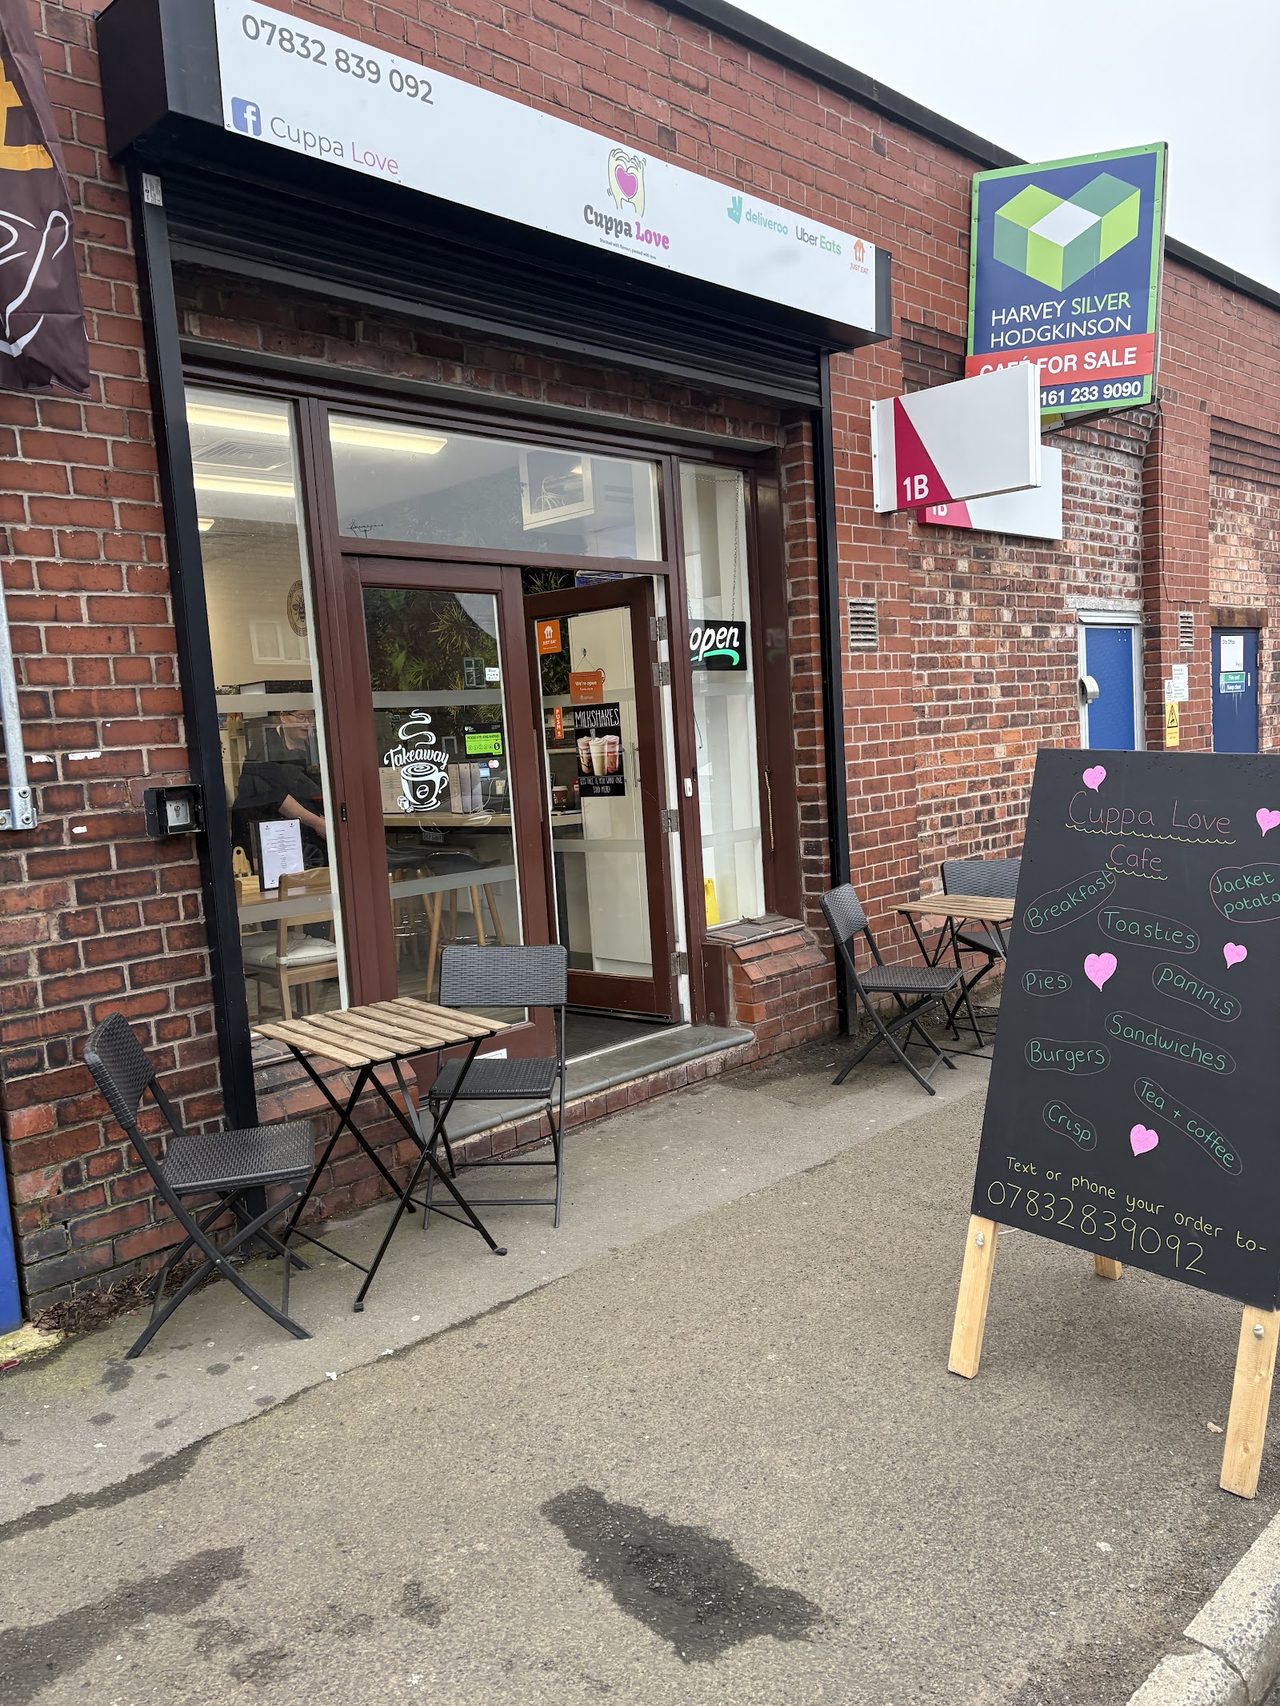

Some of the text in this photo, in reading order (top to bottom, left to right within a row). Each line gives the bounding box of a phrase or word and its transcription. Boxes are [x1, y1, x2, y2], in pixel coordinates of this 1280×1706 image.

[241, 14, 434, 105] 07832 839 092
[270, 116, 399, 175] Cuppa Love
[583, 204, 670, 250] Cuppa Love
[745, 208, 789, 235] deliveroo
[795, 225, 842, 256] Uber Eats
[849, 262, 869, 275] JUST EAT
[991, 292, 1132, 327] HARVEY SILVER
[990, 315, 1132, 349] HODGKINSON
[1037, 354, 1078, 374] FOR
[1083, 346, 1137, 370] SALE
[1041, 381, 1142, 406] 161 233 9090
[903, 473, 929, 502] 1B
[690, 626, 740, 662] open
[574, 708, 620, 728] MILKSHAKES
[383, 744, 450, 771] Takeaway
[1068, 790, 1231, 836] Cuppa Love
[1110, 843, 1162, 872] Cafe
[1027, 870, 1115, 928] Breakfast
[1212, 871, 1275, 894] Jacket
[1103, 911, 1196, 949] Toasties
[1025, 972, 1067, 992] Pies
[1030, 1041, 1105, 1071] Burgers
[1109, 1014, 1226, 1071] Sandwiches
[1048, 1104, 1092, 1144] Crisp
[1140, 1080, 1165, 1110] Tea
[1186, 1119, 1235, 1169] coffee
[1006, 1156, 1037, 1176] Text
[1045, 1169, 1062, 1181] or
[1071, 1175, 1116, 1200] phone
[1126, 1194, 1165, 1216] your
[1174, 1212, 1223, 1238] order
[987, 1180, 1207, 1276] 07832839092
